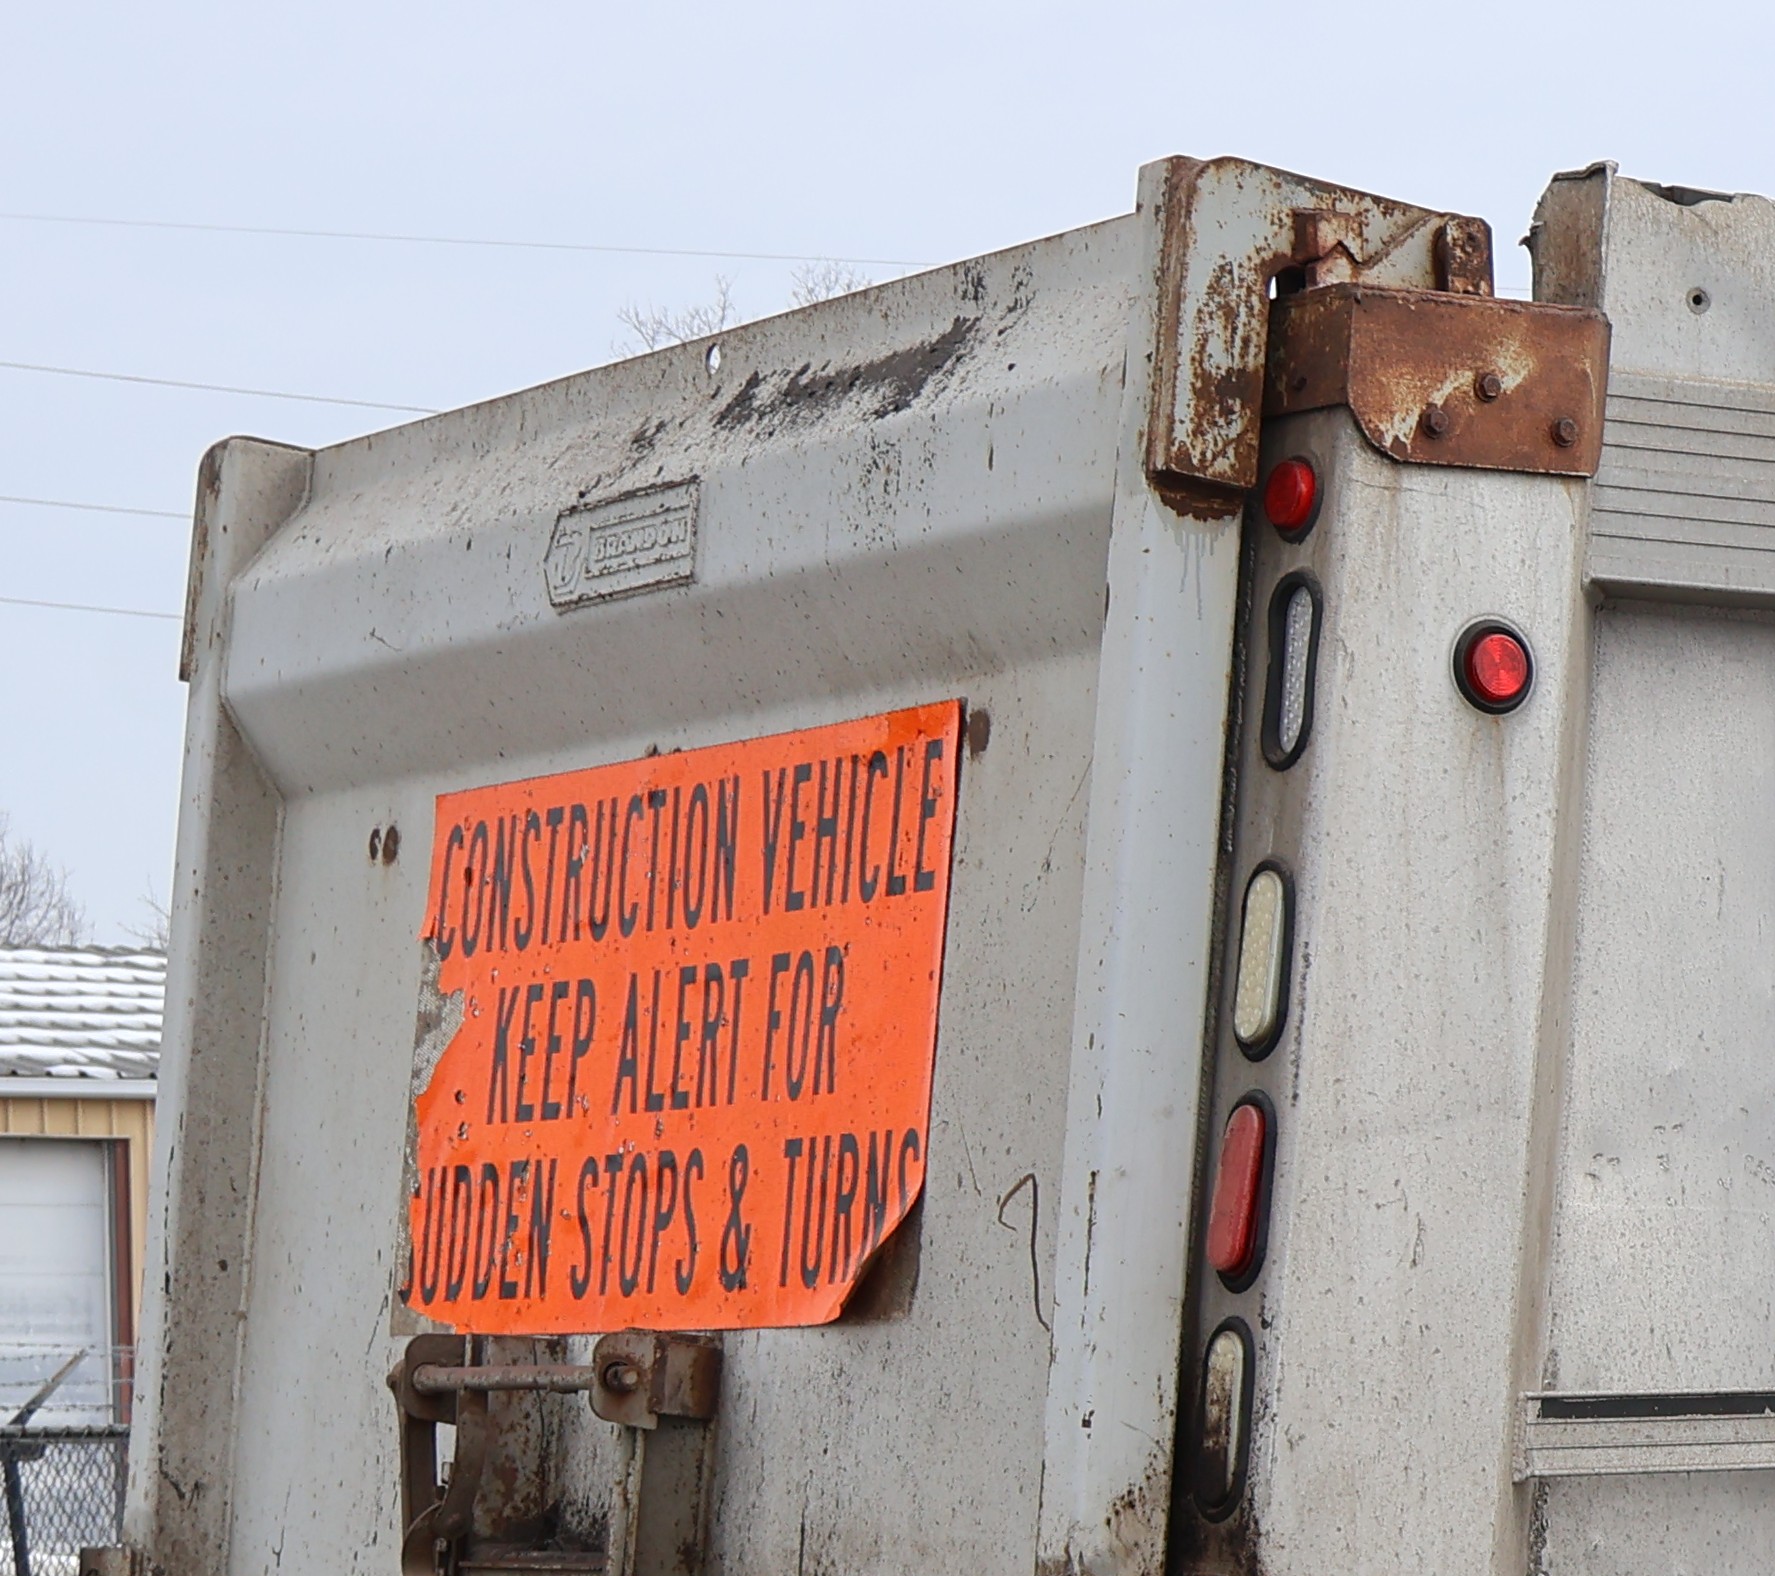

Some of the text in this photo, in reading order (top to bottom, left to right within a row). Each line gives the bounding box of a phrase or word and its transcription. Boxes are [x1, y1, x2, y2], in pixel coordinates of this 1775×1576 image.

[593, 516, 689, 563] BRANDON
[437, 739, 943, 961] CONSTRUCTION VEHICLE
[485, 944, 846, 1126] KEEP ALERT FOR
[569, 1147, 704, 1301] STOPS
[719, 1142, 751, 1293] &
